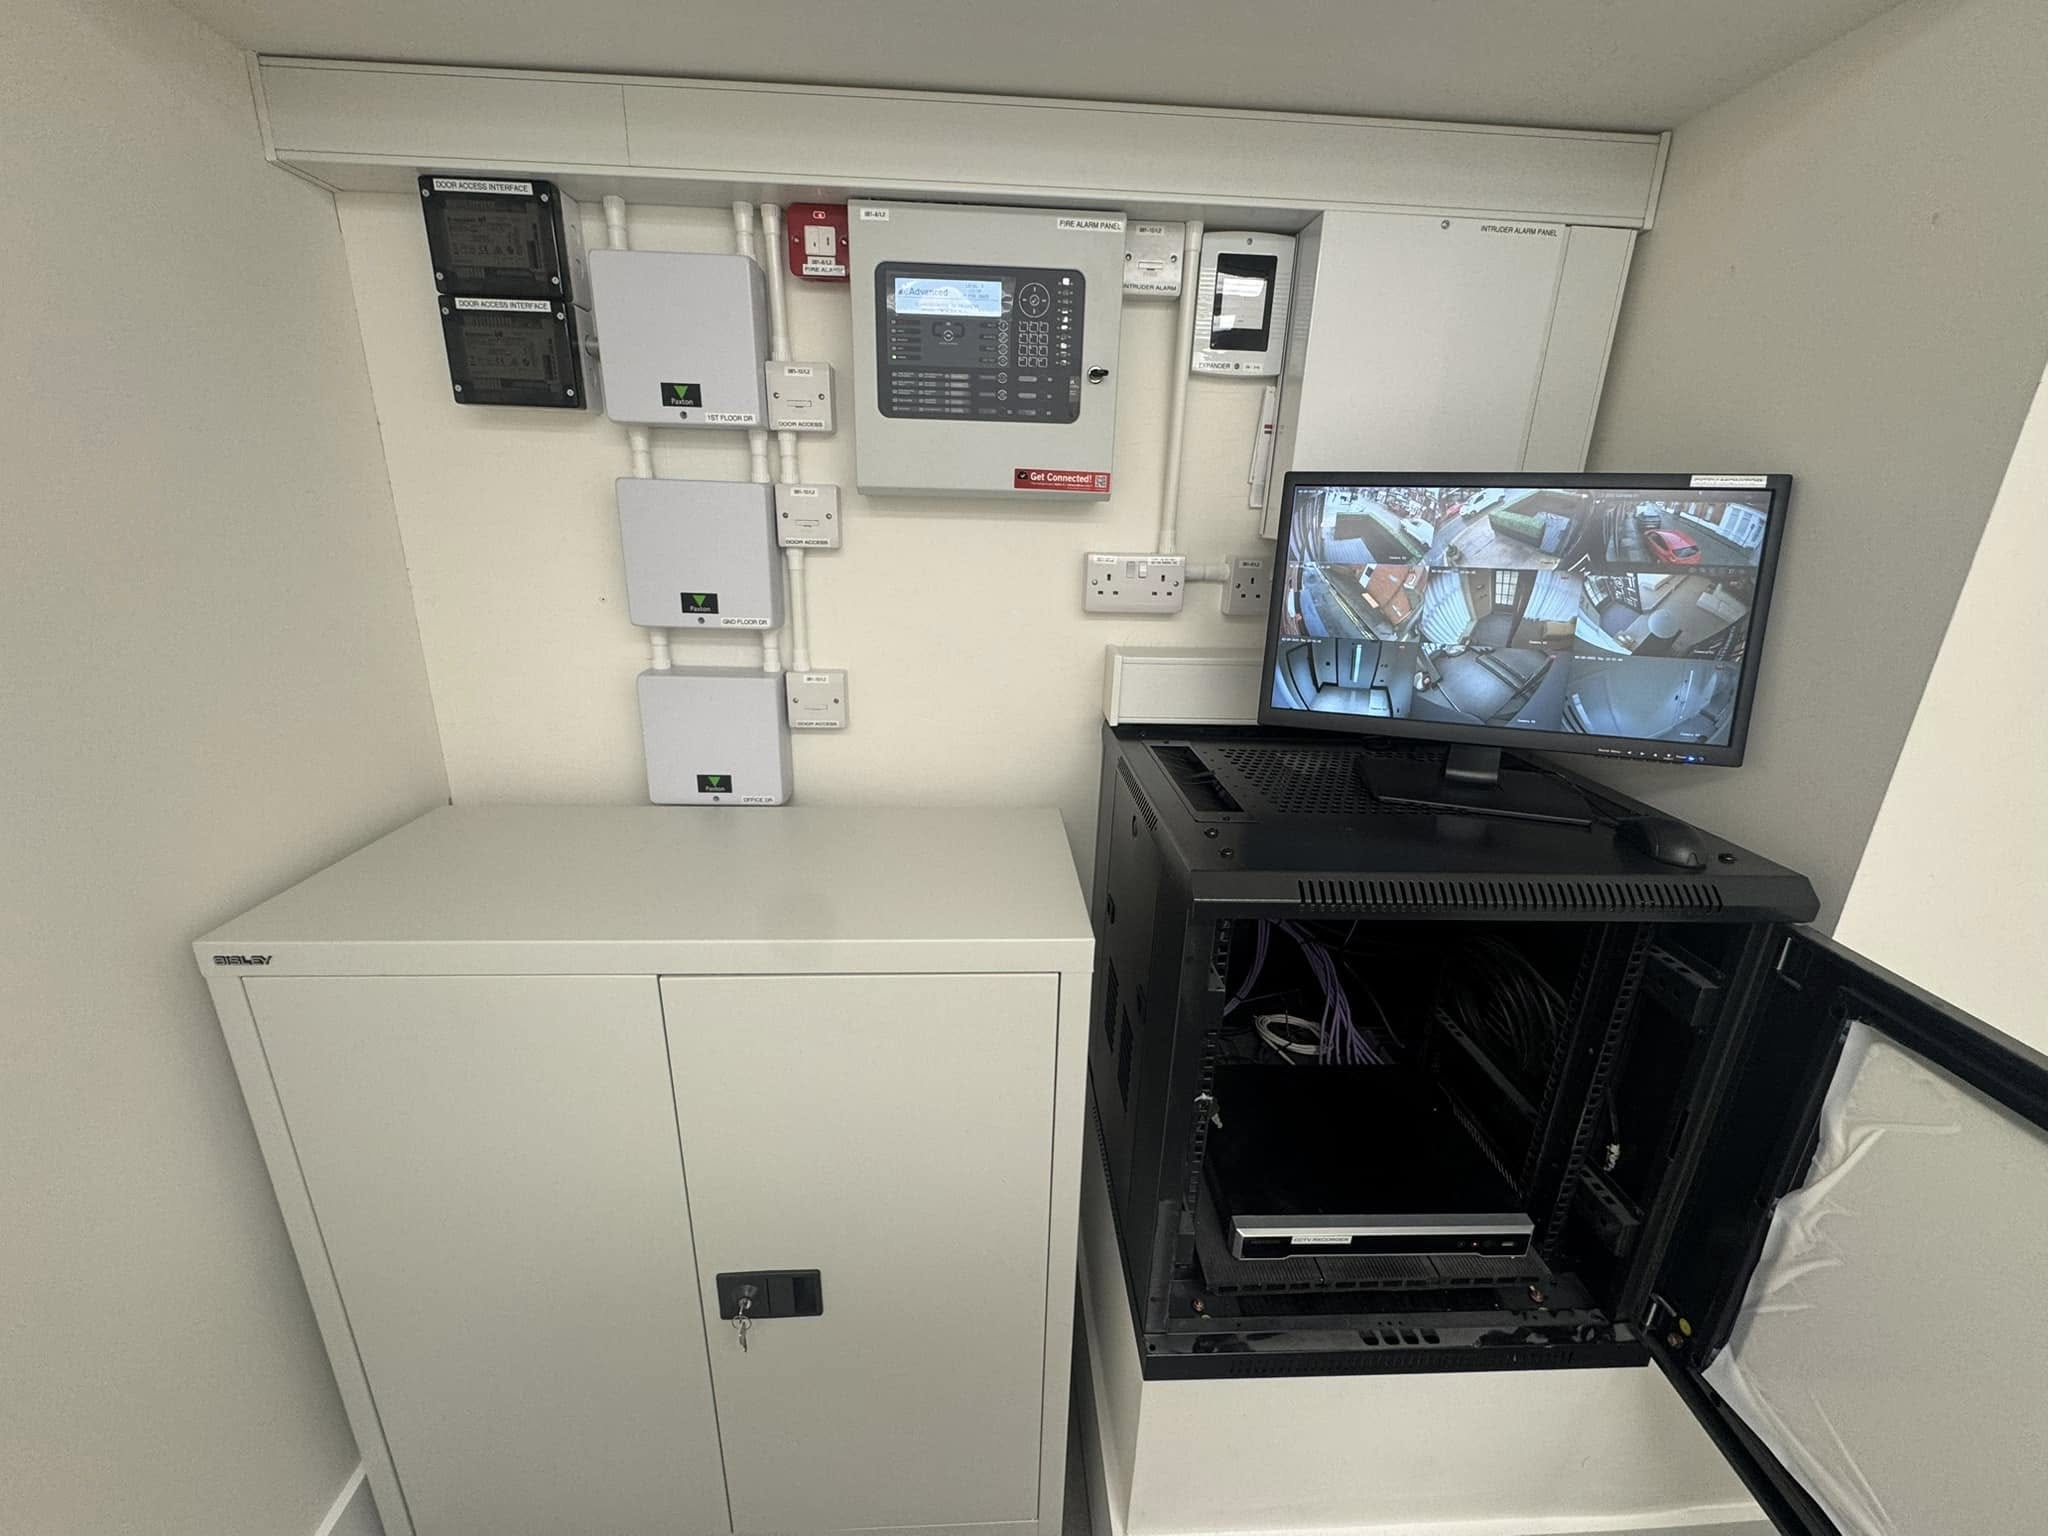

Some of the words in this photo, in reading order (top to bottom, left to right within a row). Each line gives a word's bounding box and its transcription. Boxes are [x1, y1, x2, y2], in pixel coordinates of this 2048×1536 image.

[435, 180, 457, 189] DOOR
[459, 181, 488, 191] ACCESS
[489, 183, 529, 193] INTERFACE
[1060, 220, 1075, 228] FIRE
[1076, 221, 1099, 229] ALARM
[1100, 222, 1121, 230] PANEL
[1481, 225, 1513, 234] INTRUDER
[1514, 226, 1537, 235] ALARM
[1537, 228, 1557, 237] PANEL
[909, 287, 949, 296] Advanced
[458, 299, 480, 307] DOOR
[481, 300, 508, 309] ACCESS
[510, 302, 549, 310] INTERFACE
[671, 397, 694, 406] Paxton
[1030, 472, 1044, 481] Get
[1047, 472, 1092, 483] Connected!
[213, 955, 272, 965] BISLEY
